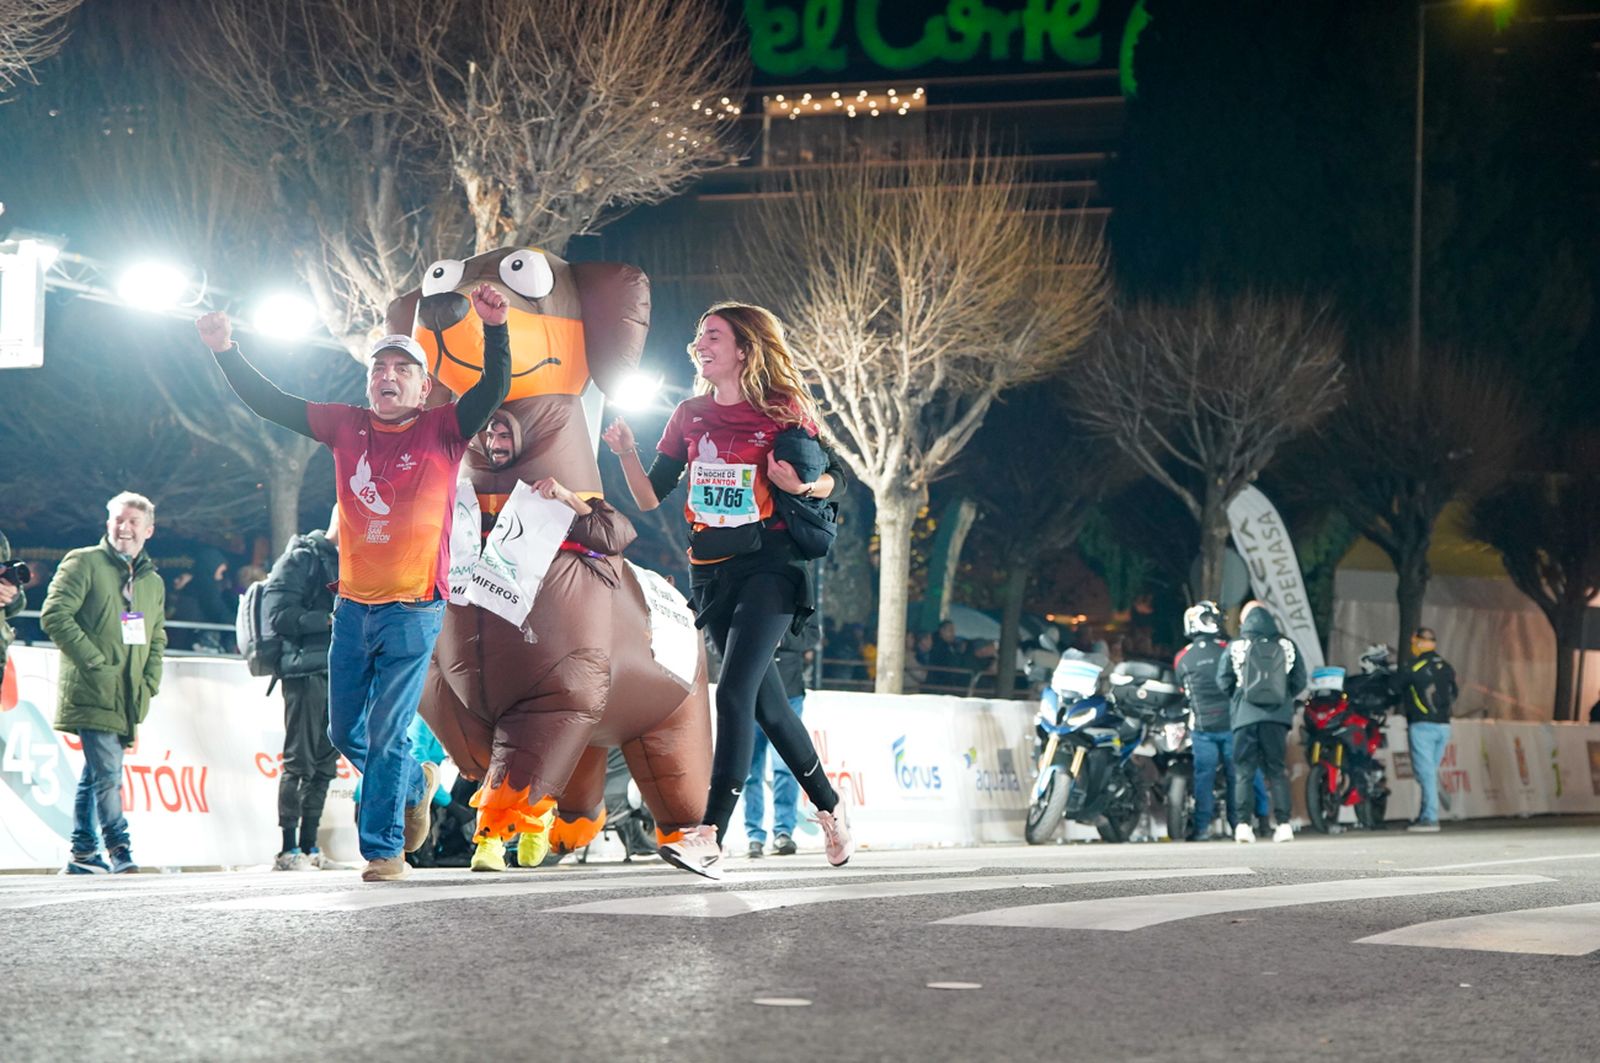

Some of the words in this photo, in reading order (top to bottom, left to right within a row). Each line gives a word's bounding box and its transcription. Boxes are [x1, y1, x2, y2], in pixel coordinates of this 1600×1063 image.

[359, 486, 376, 504] 43
[703, 486, 745, 508] 5765
[1258, 511, 1310, 632] JAPEMASA
[3, 721, 60, 806] 43
[121, 750, 209, 813] NTÓN
